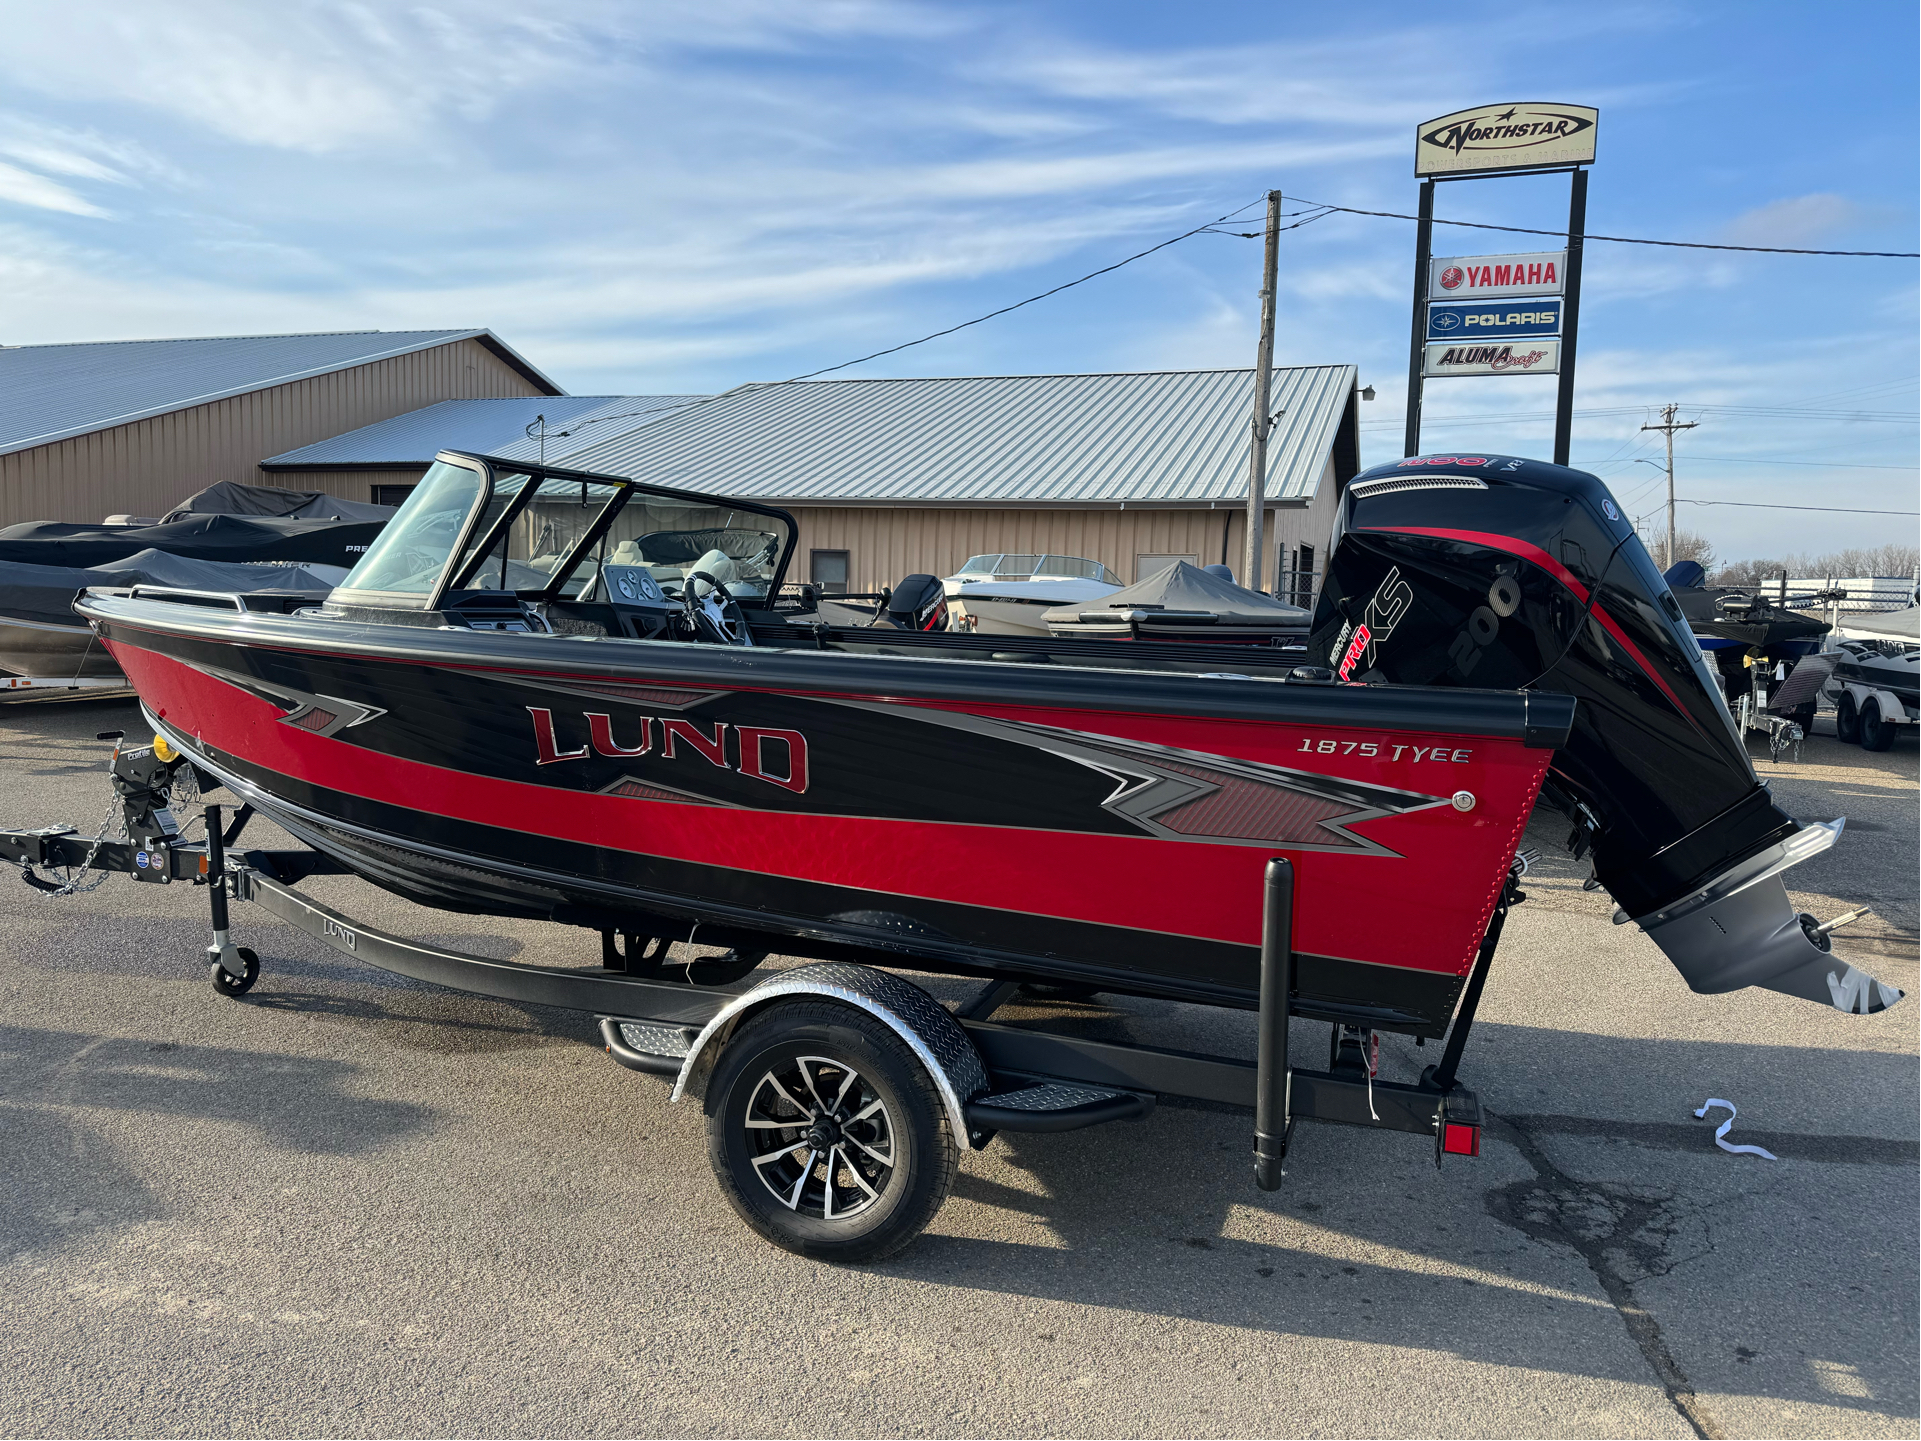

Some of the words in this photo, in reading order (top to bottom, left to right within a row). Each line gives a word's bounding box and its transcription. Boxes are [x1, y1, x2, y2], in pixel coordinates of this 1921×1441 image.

[1444, 121, 1569, 157] NORTHSTAR
[1418, 154, 1517, 171] POWERSPORTS
[1523, 153, 1532, 163] &
[1537, 147, 1594, 162] MARINE
[1466, 262, 1557, 288] YAMAHA
[1465, 312, 1556, 327] POLARIS
[1329, 618, 1352, 666] MERCURY
[1448, 575, 1522, 677] 200
[1338, 623, 1372, 682] PRO
[526, 706, 809, 794] LUND
[1297, 738, 1379, 757] 1875
[1391, 744, 1473, 764] TYEE
[323, 919, 356, 951] LUND
